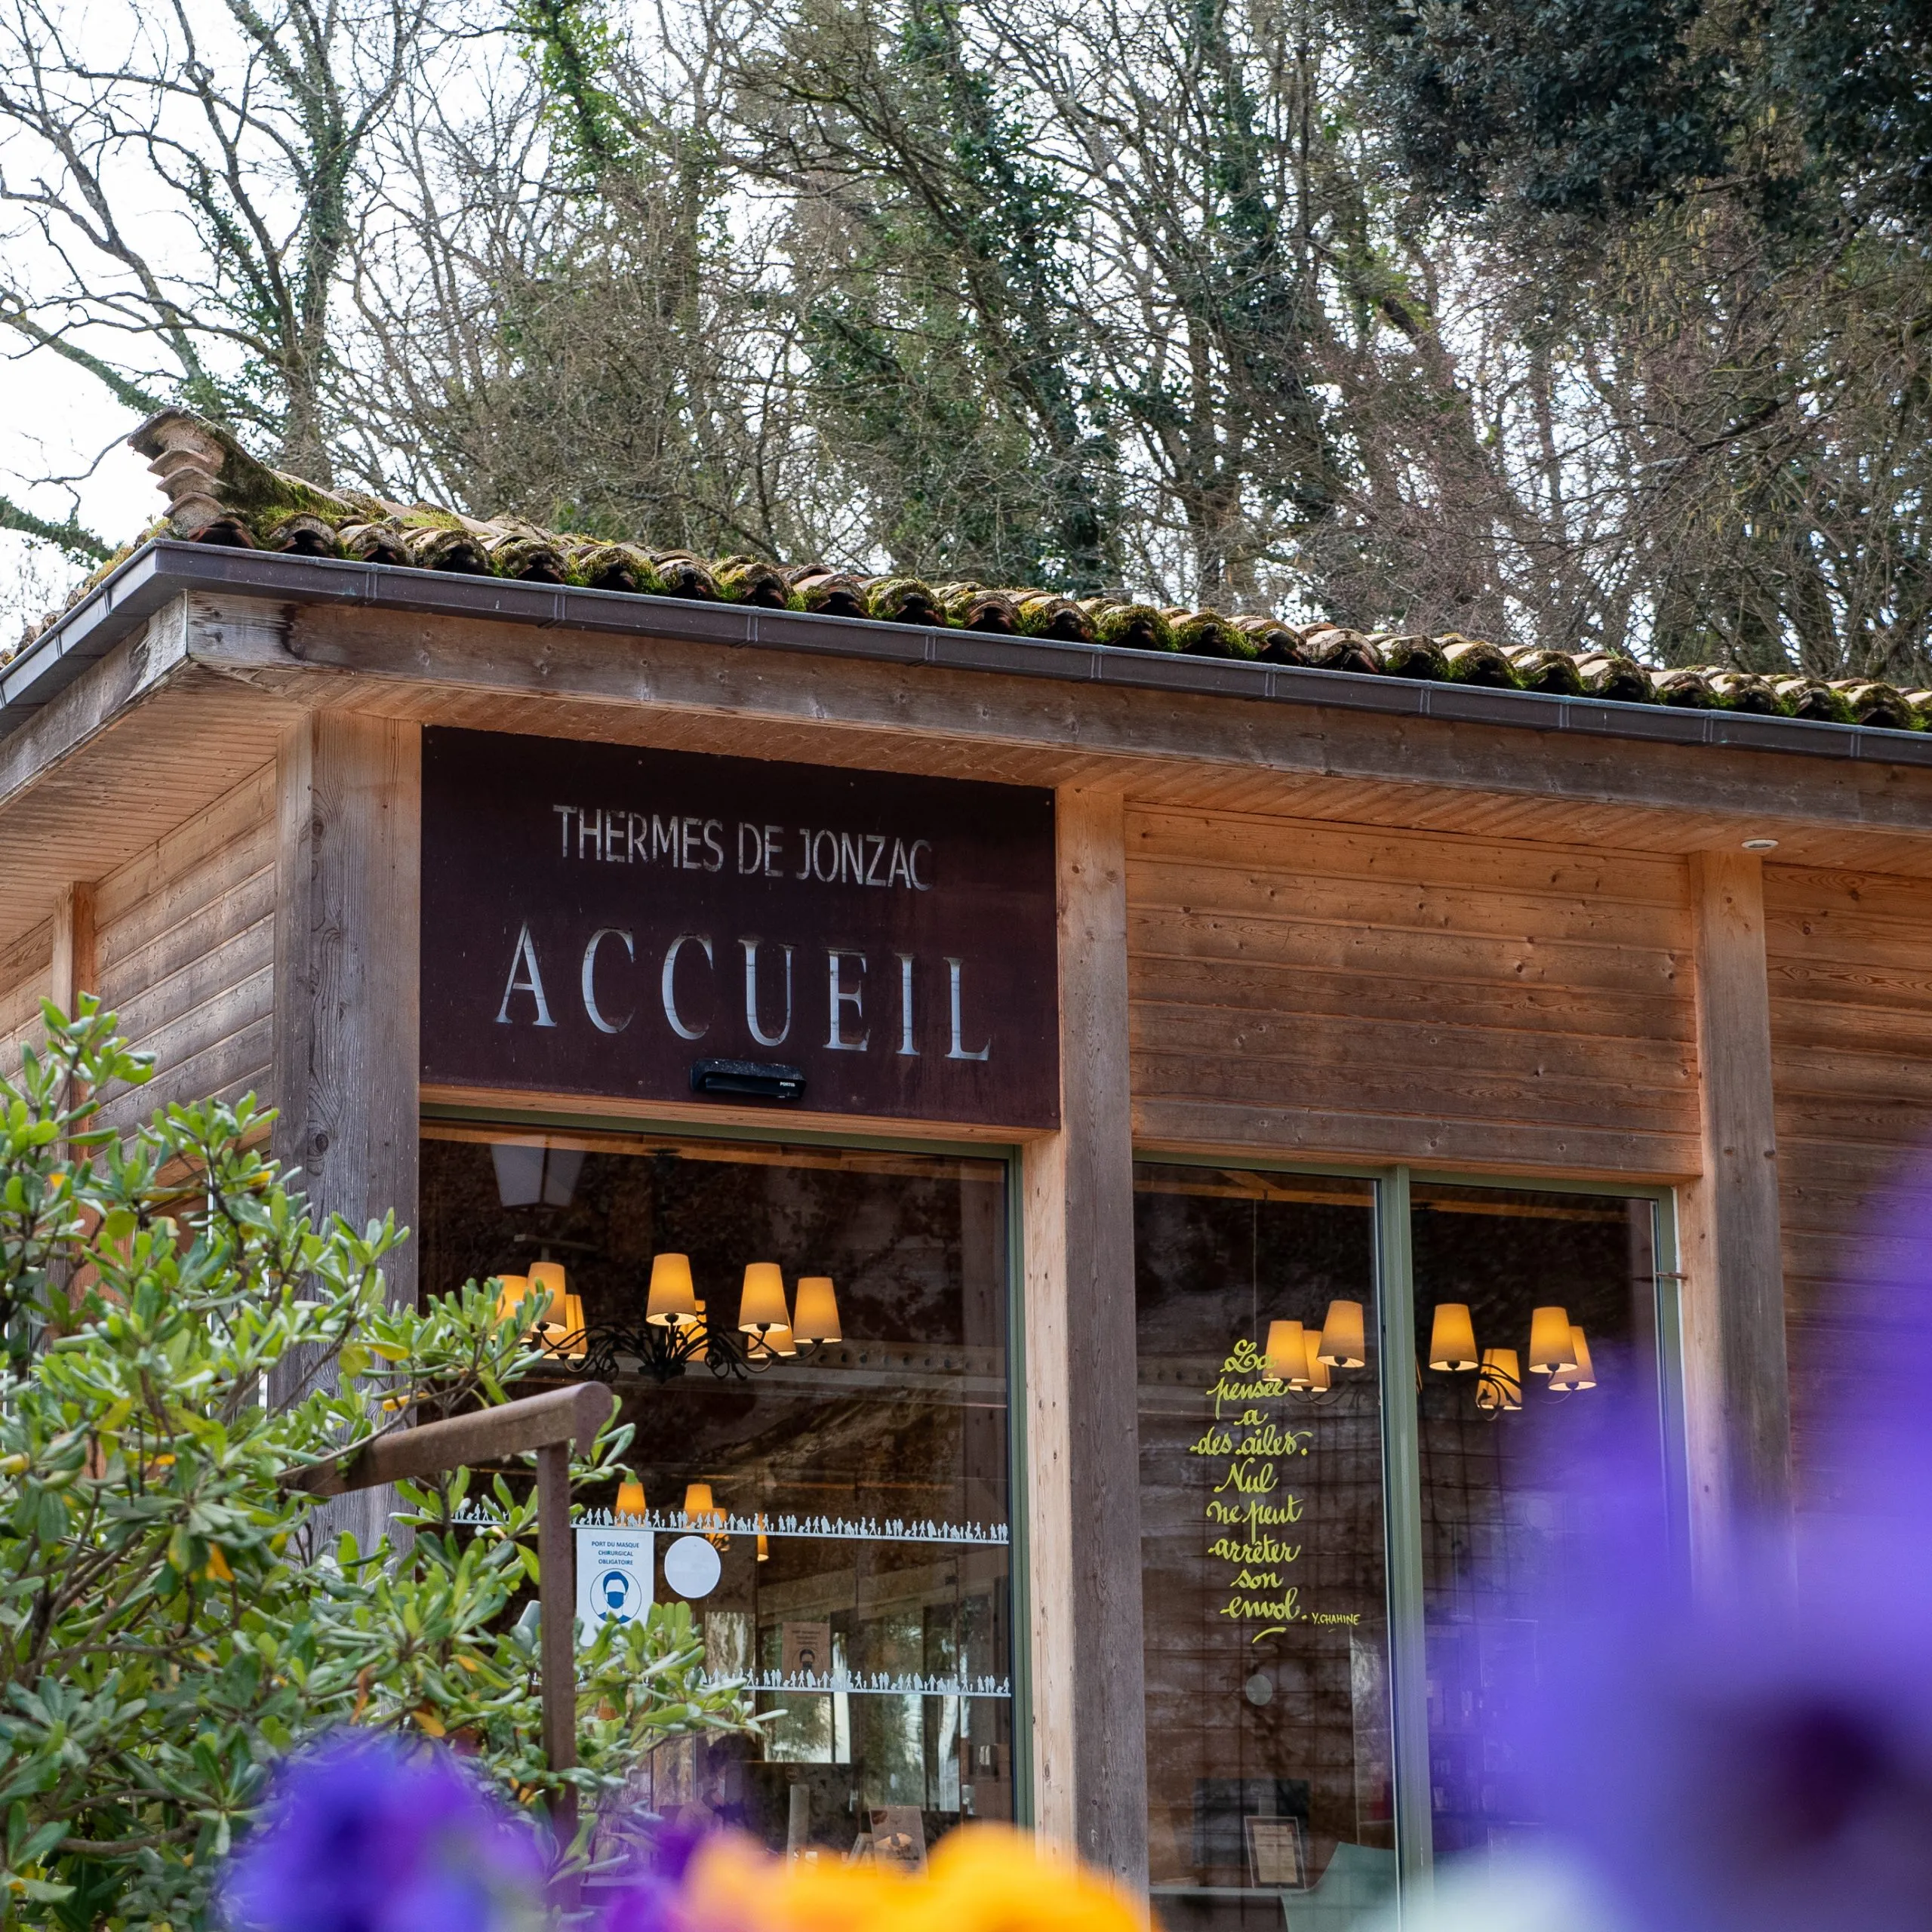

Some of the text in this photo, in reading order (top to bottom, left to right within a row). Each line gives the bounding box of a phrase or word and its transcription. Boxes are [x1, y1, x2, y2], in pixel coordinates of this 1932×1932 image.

[552, 804, 934, 891] THERMES DE JONZAC
[494, 920, 991, 1061] ACCUEIL
[1220, 1339, 1278, 1374] La
[1233, 1408, 1269, 1426] a
[1189, 1426, 1233, 1456] des
[1213, 1457, 1278, 1494] Nul
[1205, 1494, 1305, 1545] ne peut
[1207, 1533, 1302, 1564] arrêter
[1229, 1568, 1284, 1589] son
